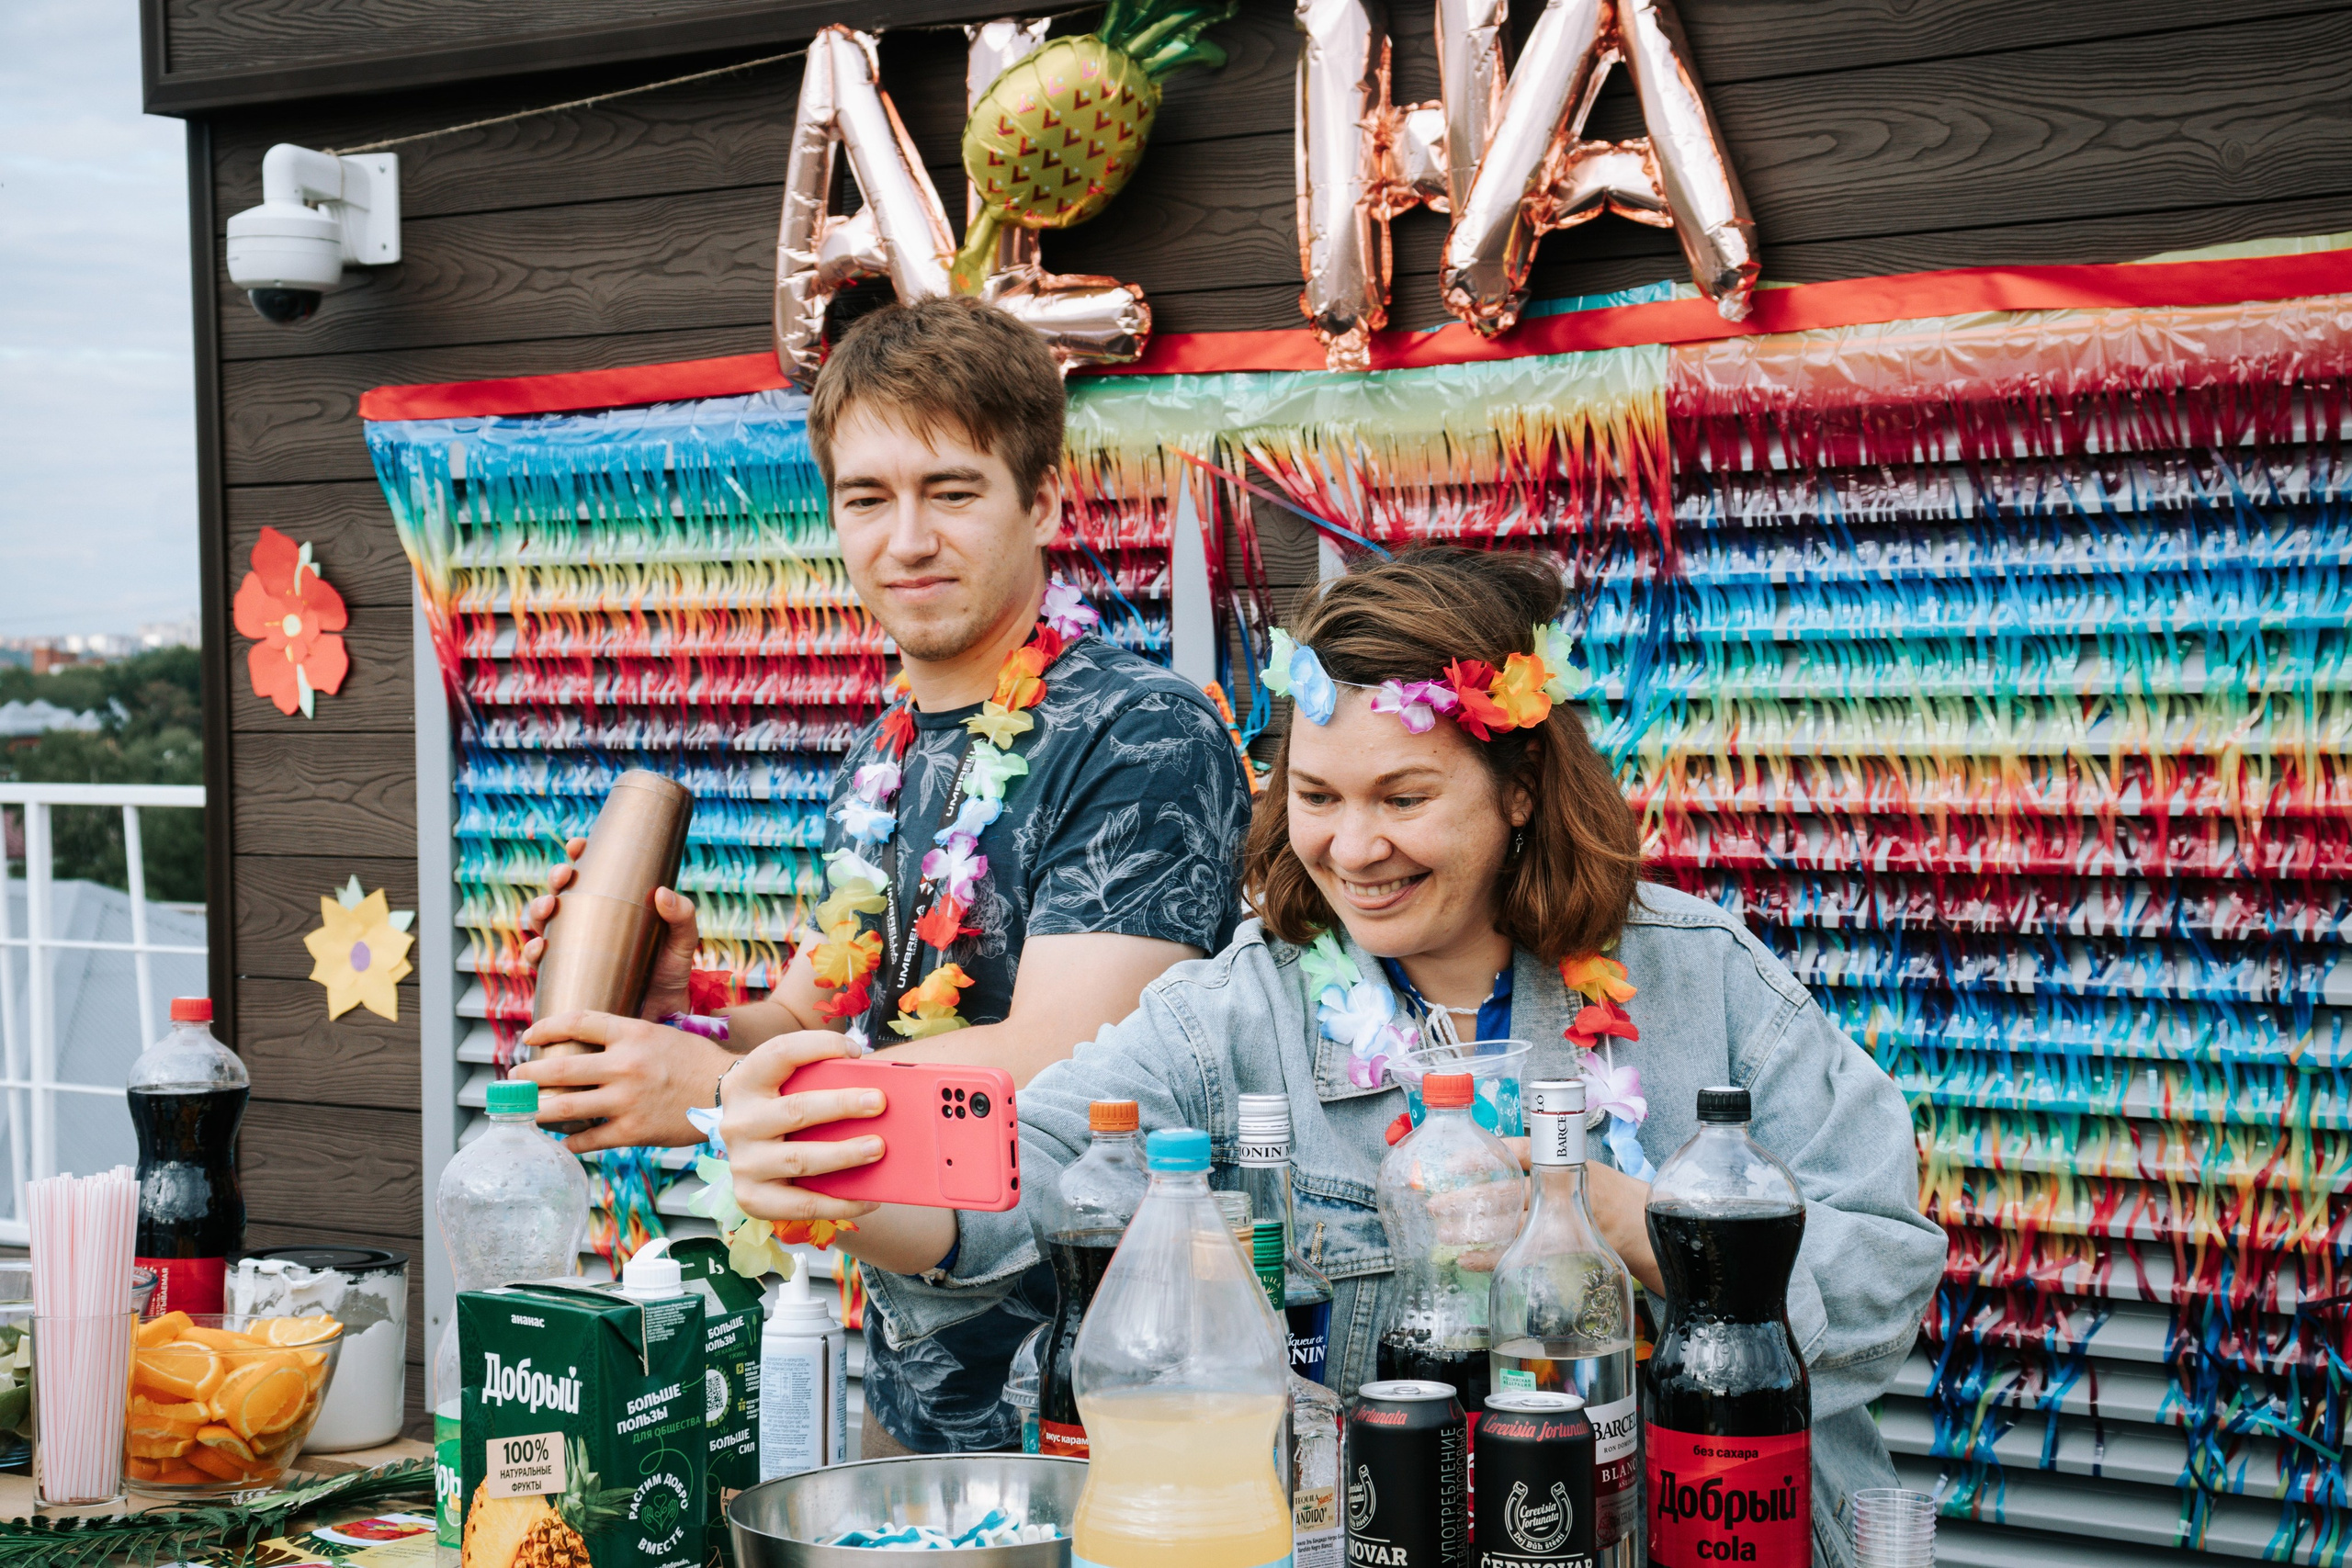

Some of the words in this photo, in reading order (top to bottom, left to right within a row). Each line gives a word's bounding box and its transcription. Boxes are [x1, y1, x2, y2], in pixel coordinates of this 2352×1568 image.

[1239, 1145, 1283, 1158] ONIN
[511, 1314, 546, 1328] ананас
[707, 1314, 745, 1340] БОЛЬШЕ
[728, 1349, 748, 1360] УЖИНА
[481, 1351, 581, 1415] Добрый
[627, 1382, 683, 1416] БОЛЬШЕ
[616, 1404, 669, 1435] ПОЛЬЗЫ
[632, 1429, 652, 1445] ДЛЯ
[654, 1416, 702, 1438] ОБЩЕСТВА
[1483, 1412, 1537, 1438] Cerevisia
[709, 1427, 751, 1452] БОЛЬШЕ
[738, 1441, 755, 1455] СИЛ
[1046, 1432, 1061, 1443] вкус
[1603, 1444, 1617, 1454] RON
[503, 1437, 549, 1464] 100%
[1692, 1444, 1714, 1458] без
[1715, 1448, 1759, 1461] сахара
[500, 1464, 552, 1480] НАТУРАЛЬНЫЕ
[511, 1480, 542, 1493] ФРУКТЫ
[628, 1472, 662, 1520] РАСТИМ
[662, 1472, 689, 1510] ДОБРО
[1441, 1427, 1457, 1563] УПОТРЕБЛЕНИЕ
[1294, 1494, 1319, 1505] TEQUILA
[1519, 1502, 1557, 1518] Cerevisia
[1657, 1469, 1798, 1530] Добрый
[1456, 1503, 1466, 1559] ВАШЕМУ
[1521, 1512, 1560, 1531] fortunata
[637, 1526, 684, 1555] ВМЕСТЕ
[1512, 1531, 1527, 1546] Dej
[1696, 1535, 1757, 1562] cola
